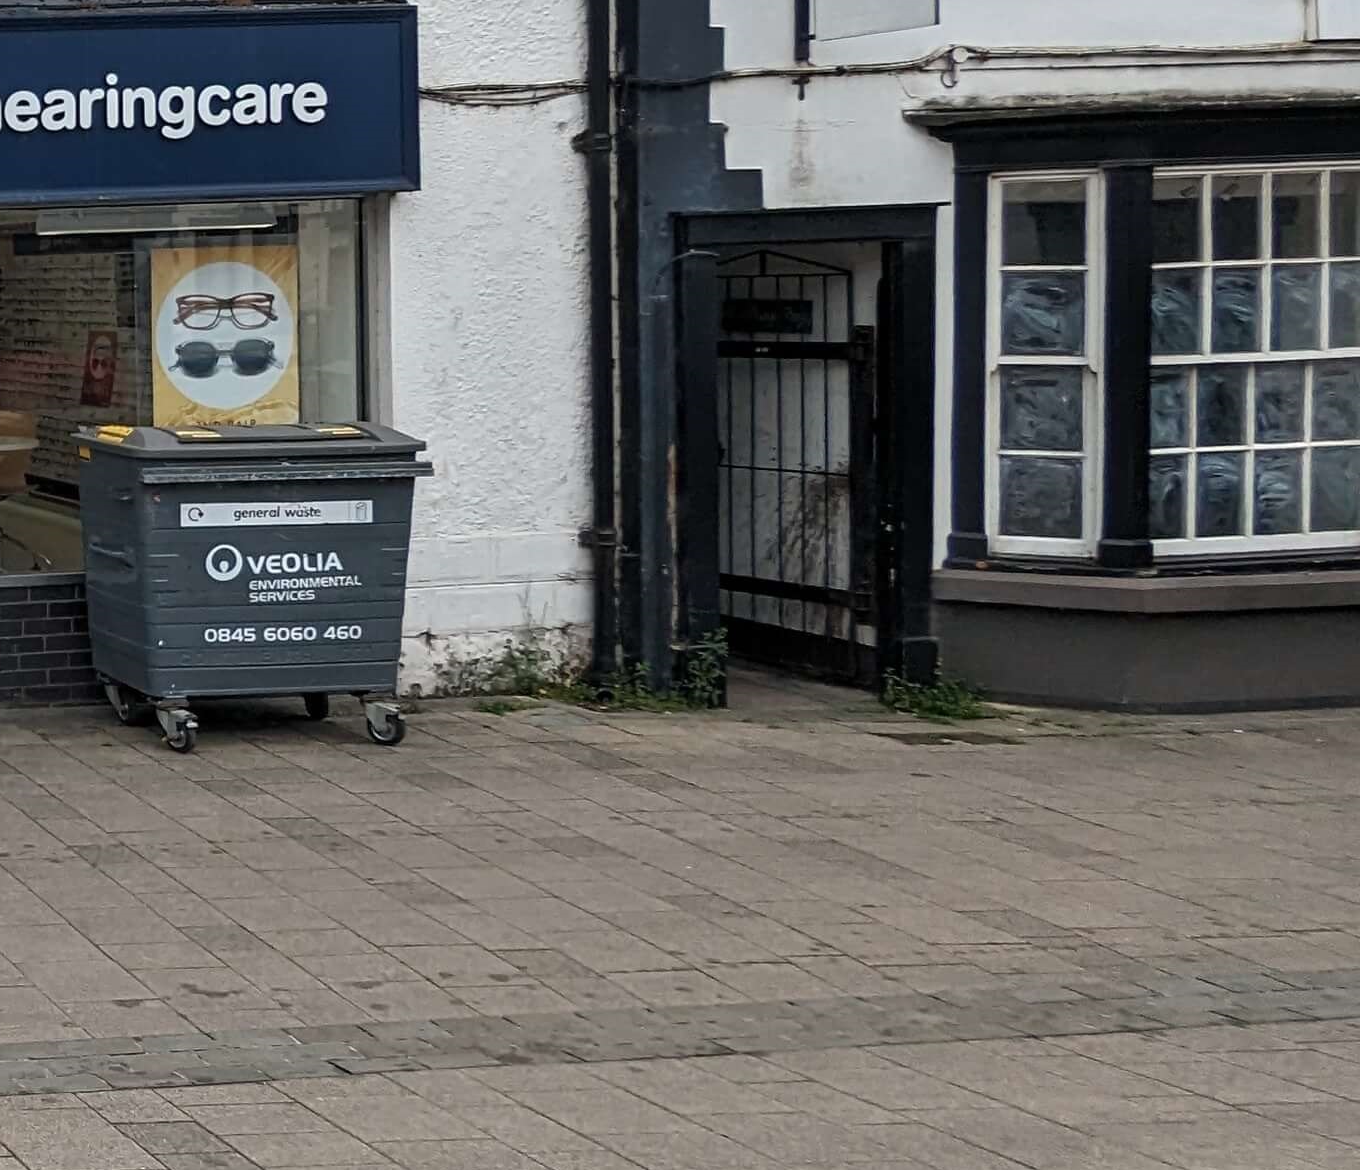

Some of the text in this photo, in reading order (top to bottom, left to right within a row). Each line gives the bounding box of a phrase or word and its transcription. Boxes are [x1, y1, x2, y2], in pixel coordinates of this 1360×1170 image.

[234, 506, 321, 521] general waste
[246, 552, 344, 575] VEOLIA
[248, 575, 363, 591] ENVIRONMENTAL
[249, 589, 316, 603] SERVICES
[204, 625, 362, 643] 0845 6060 460
